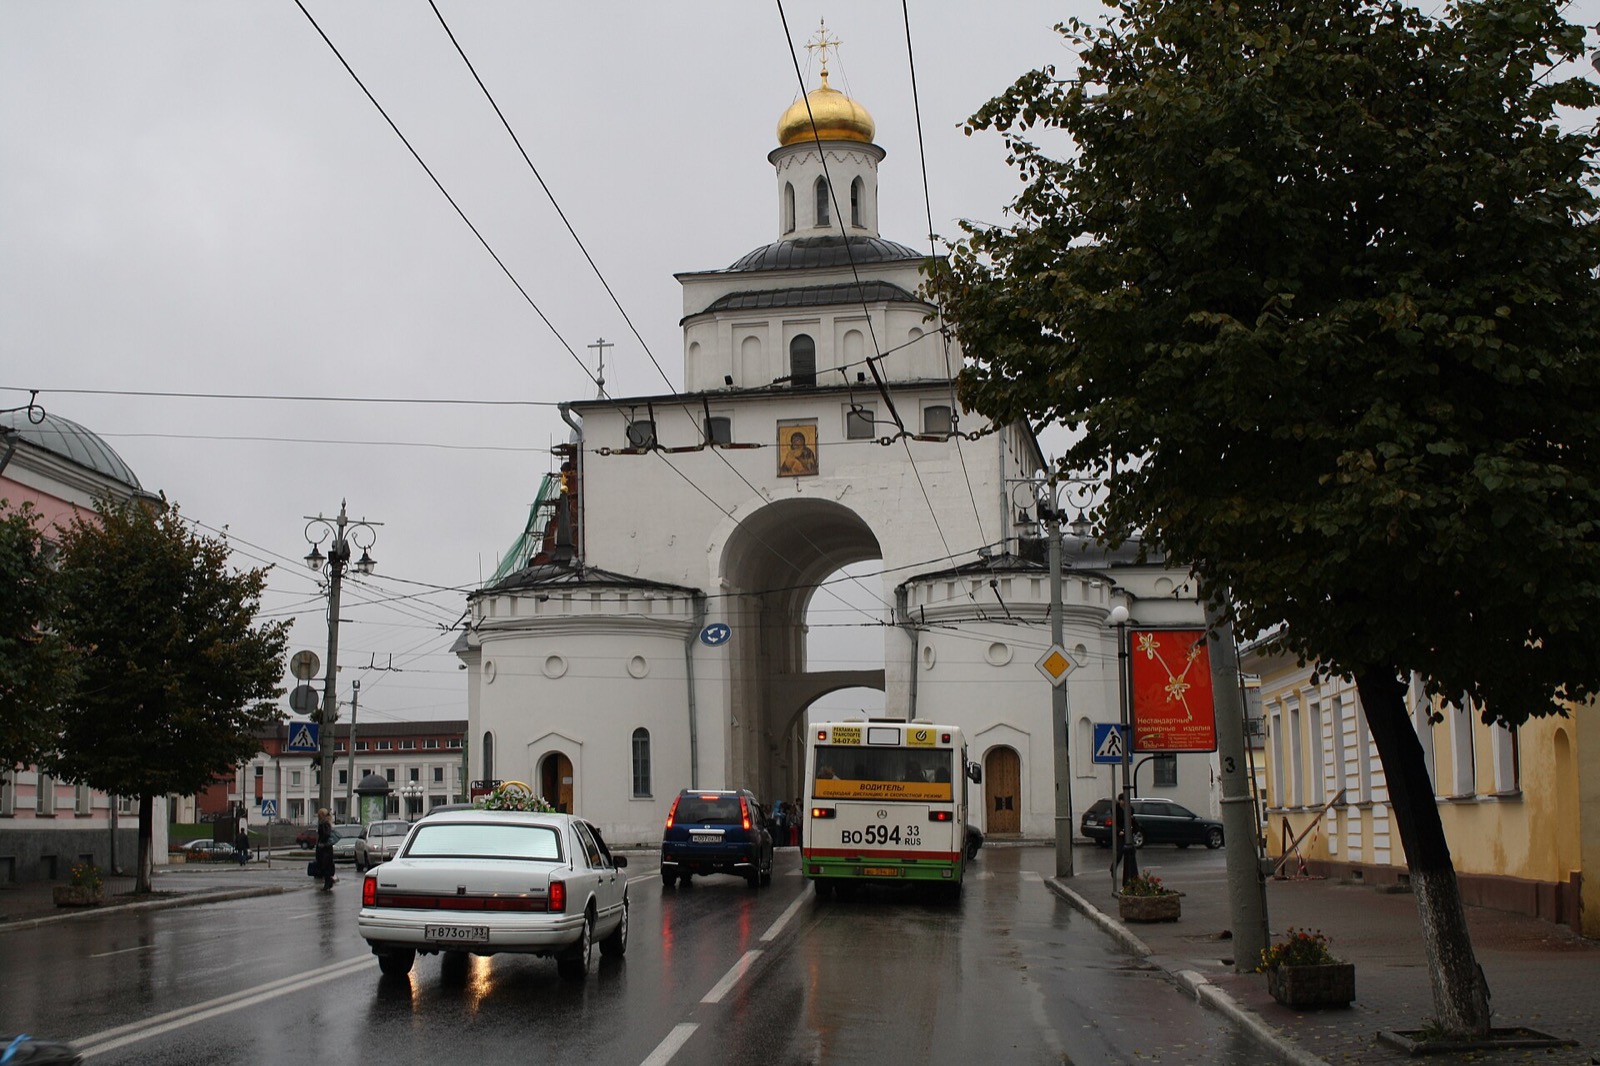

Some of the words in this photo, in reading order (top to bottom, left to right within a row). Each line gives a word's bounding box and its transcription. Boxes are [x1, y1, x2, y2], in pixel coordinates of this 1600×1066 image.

[1137, 717, 1190, 725] Нестандартные
[1225, 756, 1235, 773] 3
[860, 783, 905, 792] ВОДИТЕЛЬ!
[907, 825, 920, 836] 33
[904, 838, 922, 846] RUS
